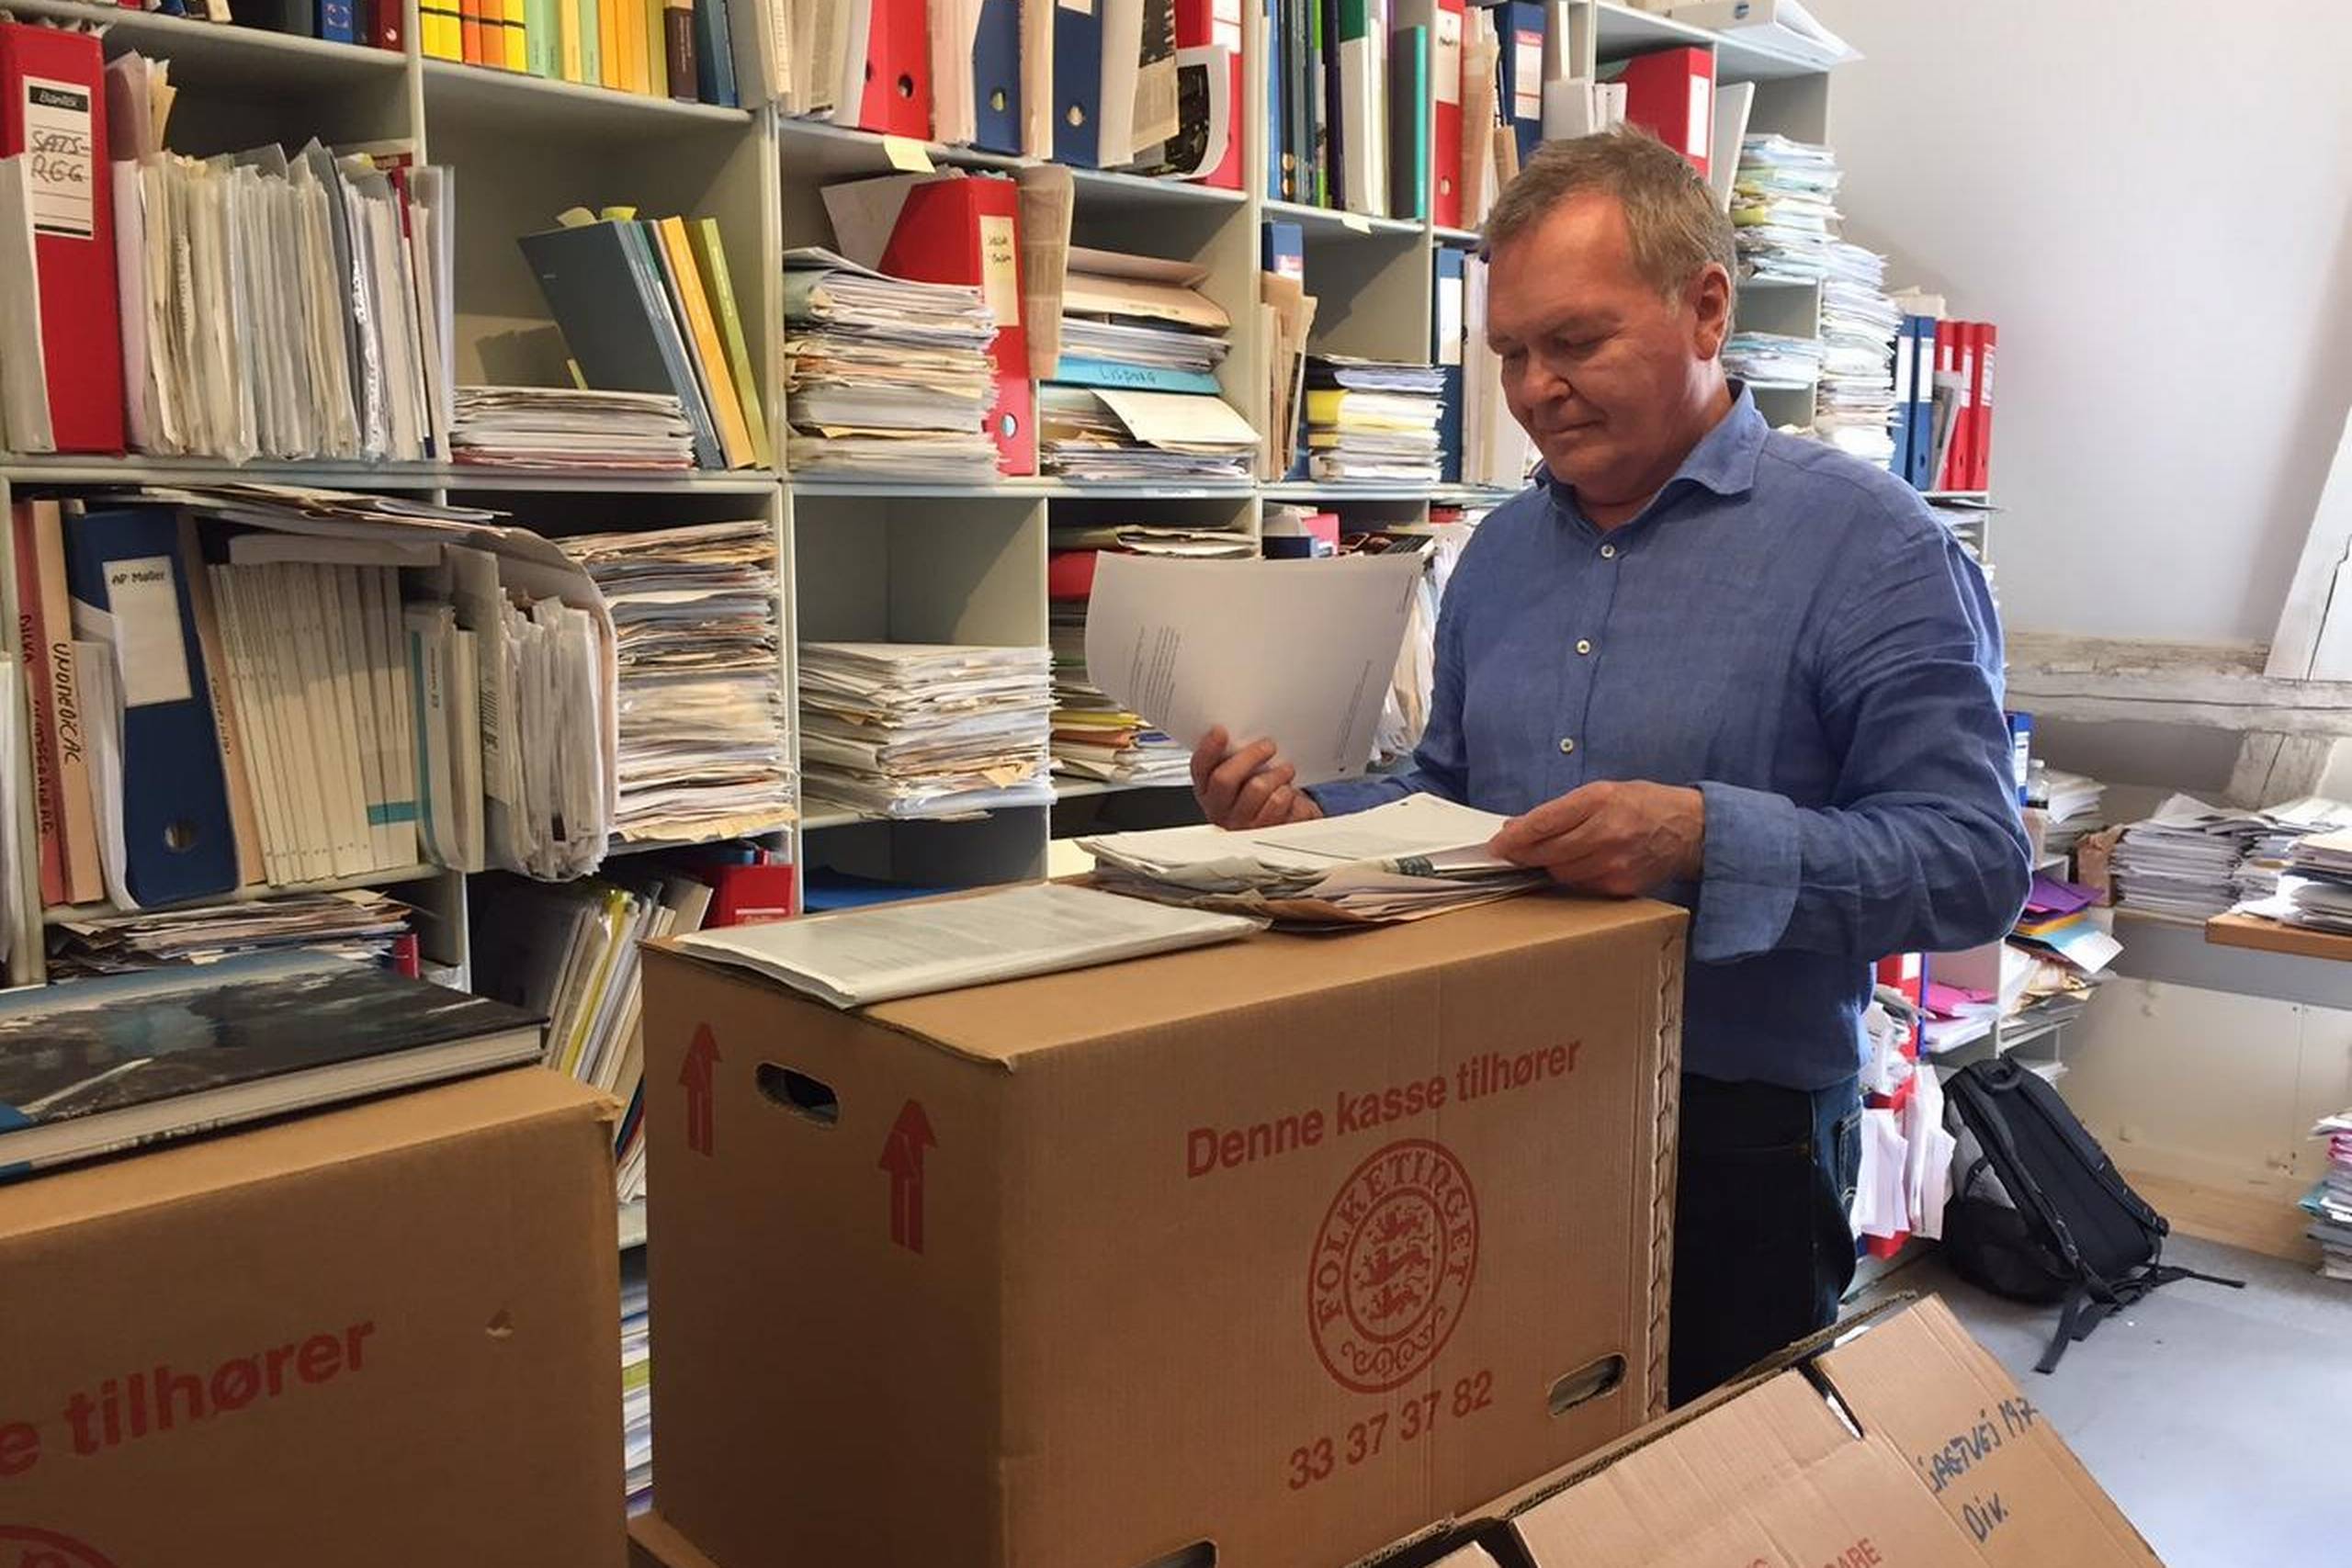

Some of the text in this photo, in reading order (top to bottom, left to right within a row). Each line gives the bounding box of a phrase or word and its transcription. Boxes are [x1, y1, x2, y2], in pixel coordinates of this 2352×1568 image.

[1185, 1039, 1582, 1179] Denne kasse tilhører
[63, 1320, 376, 1458] tilhører
[1288, 1371, 1494, 1492] 33 37 37 82
